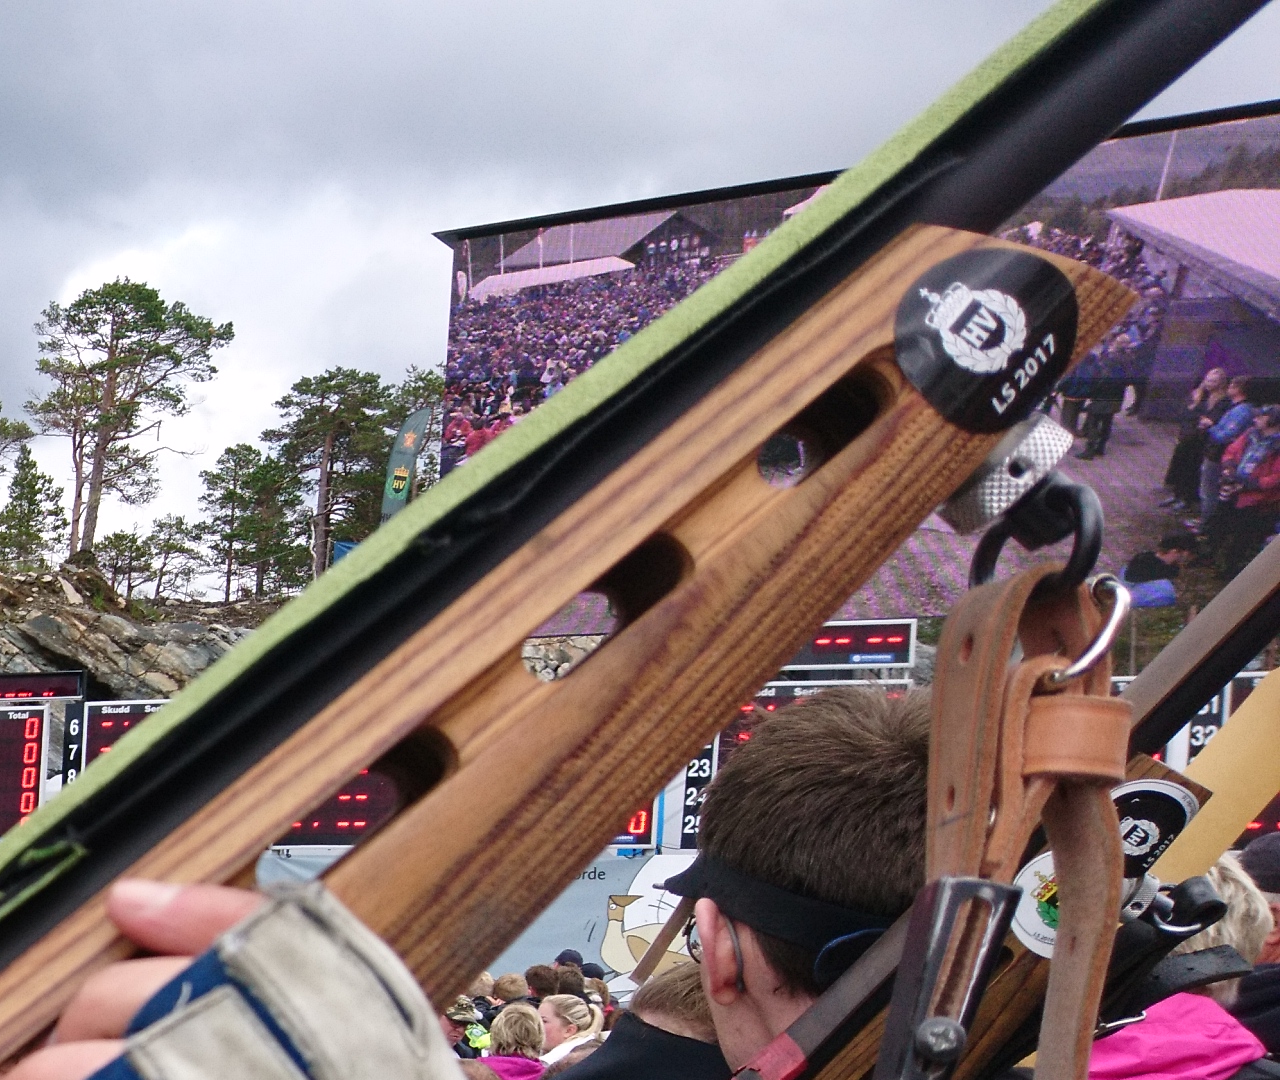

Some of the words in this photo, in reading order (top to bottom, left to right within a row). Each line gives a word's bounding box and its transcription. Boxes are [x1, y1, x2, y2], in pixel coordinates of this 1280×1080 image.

[960, 306, 998, 349] HV
[991, 382, 1016, 415] LS
[1014, 333, 1056, 391] 2017
[392, 479, 406, 490] HV
[8, 711, 29, 719] Total
[101, 705, 130, 714] Skudd
[24, 717, 39, 739] 0
[69, 719, 79, 735] 6
[23, 742, 38, 764] 0
[68, 744, 78, 760] 7
[21, 766, 37, 788] 0
[687, 758, 711, 778] 23
[20, 791, 35, 813] 0
[1126, 827, 1146, 846] HV
